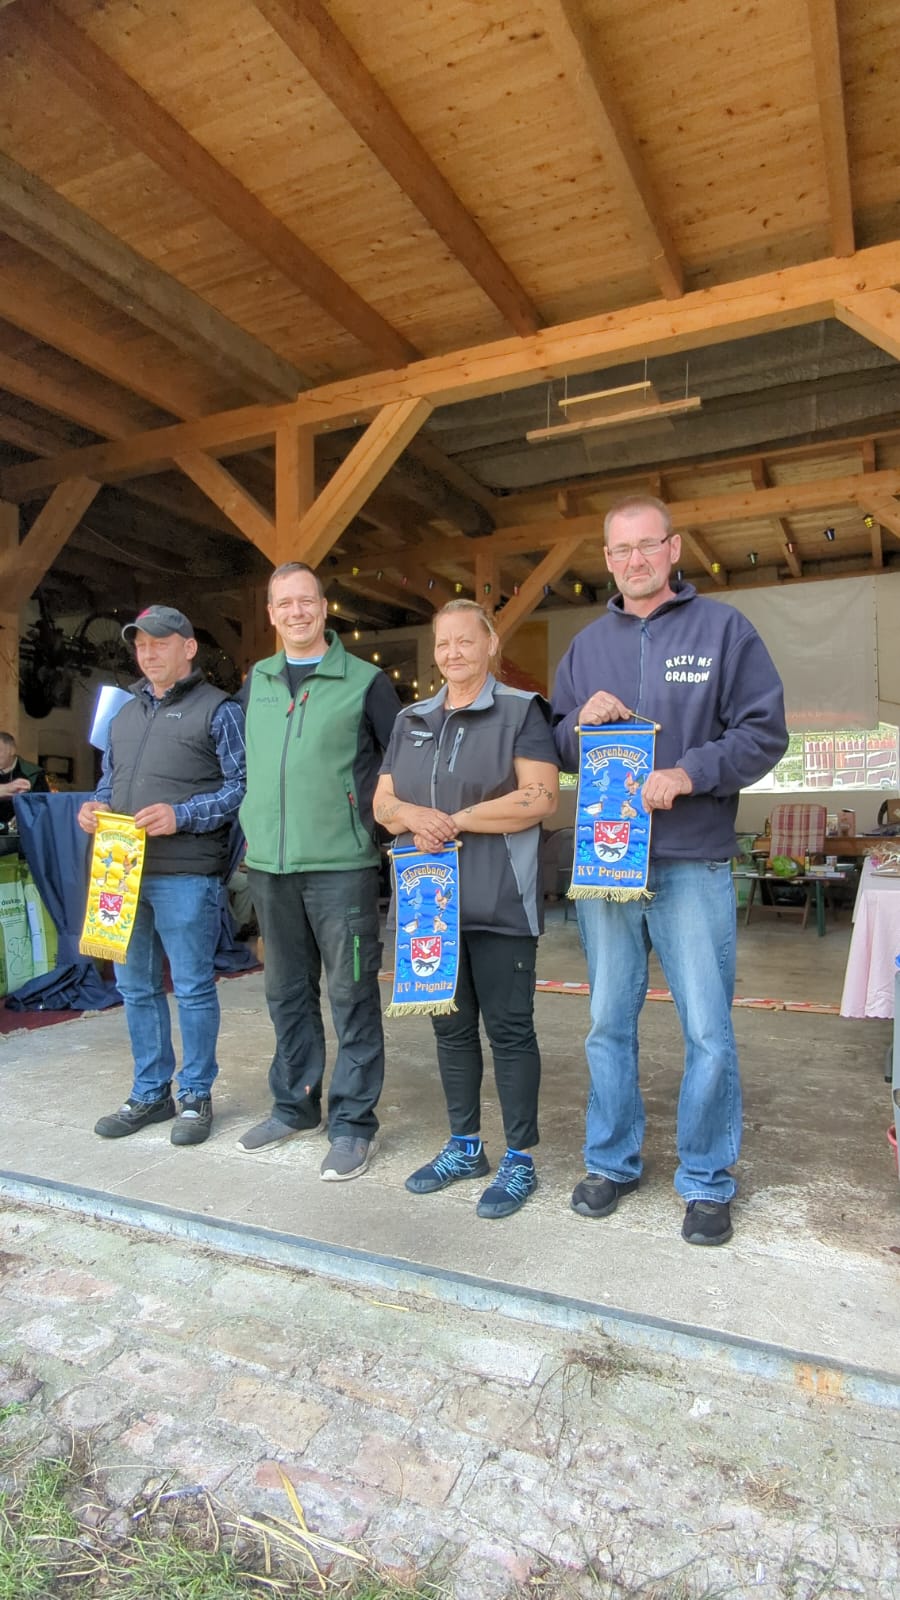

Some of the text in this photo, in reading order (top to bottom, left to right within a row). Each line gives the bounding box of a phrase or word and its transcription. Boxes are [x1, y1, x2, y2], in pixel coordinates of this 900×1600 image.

[665, 655, 695, 668] RKZV
[665, 671, 710, 683] GRABOW
[589, 747, 641, 763] Ehrenband
[403, 865, 448, 882] Ehrenband
[577, 866, 643, 880] KV Prignitz
[397, 981, 453, 993] KV Prignitz
